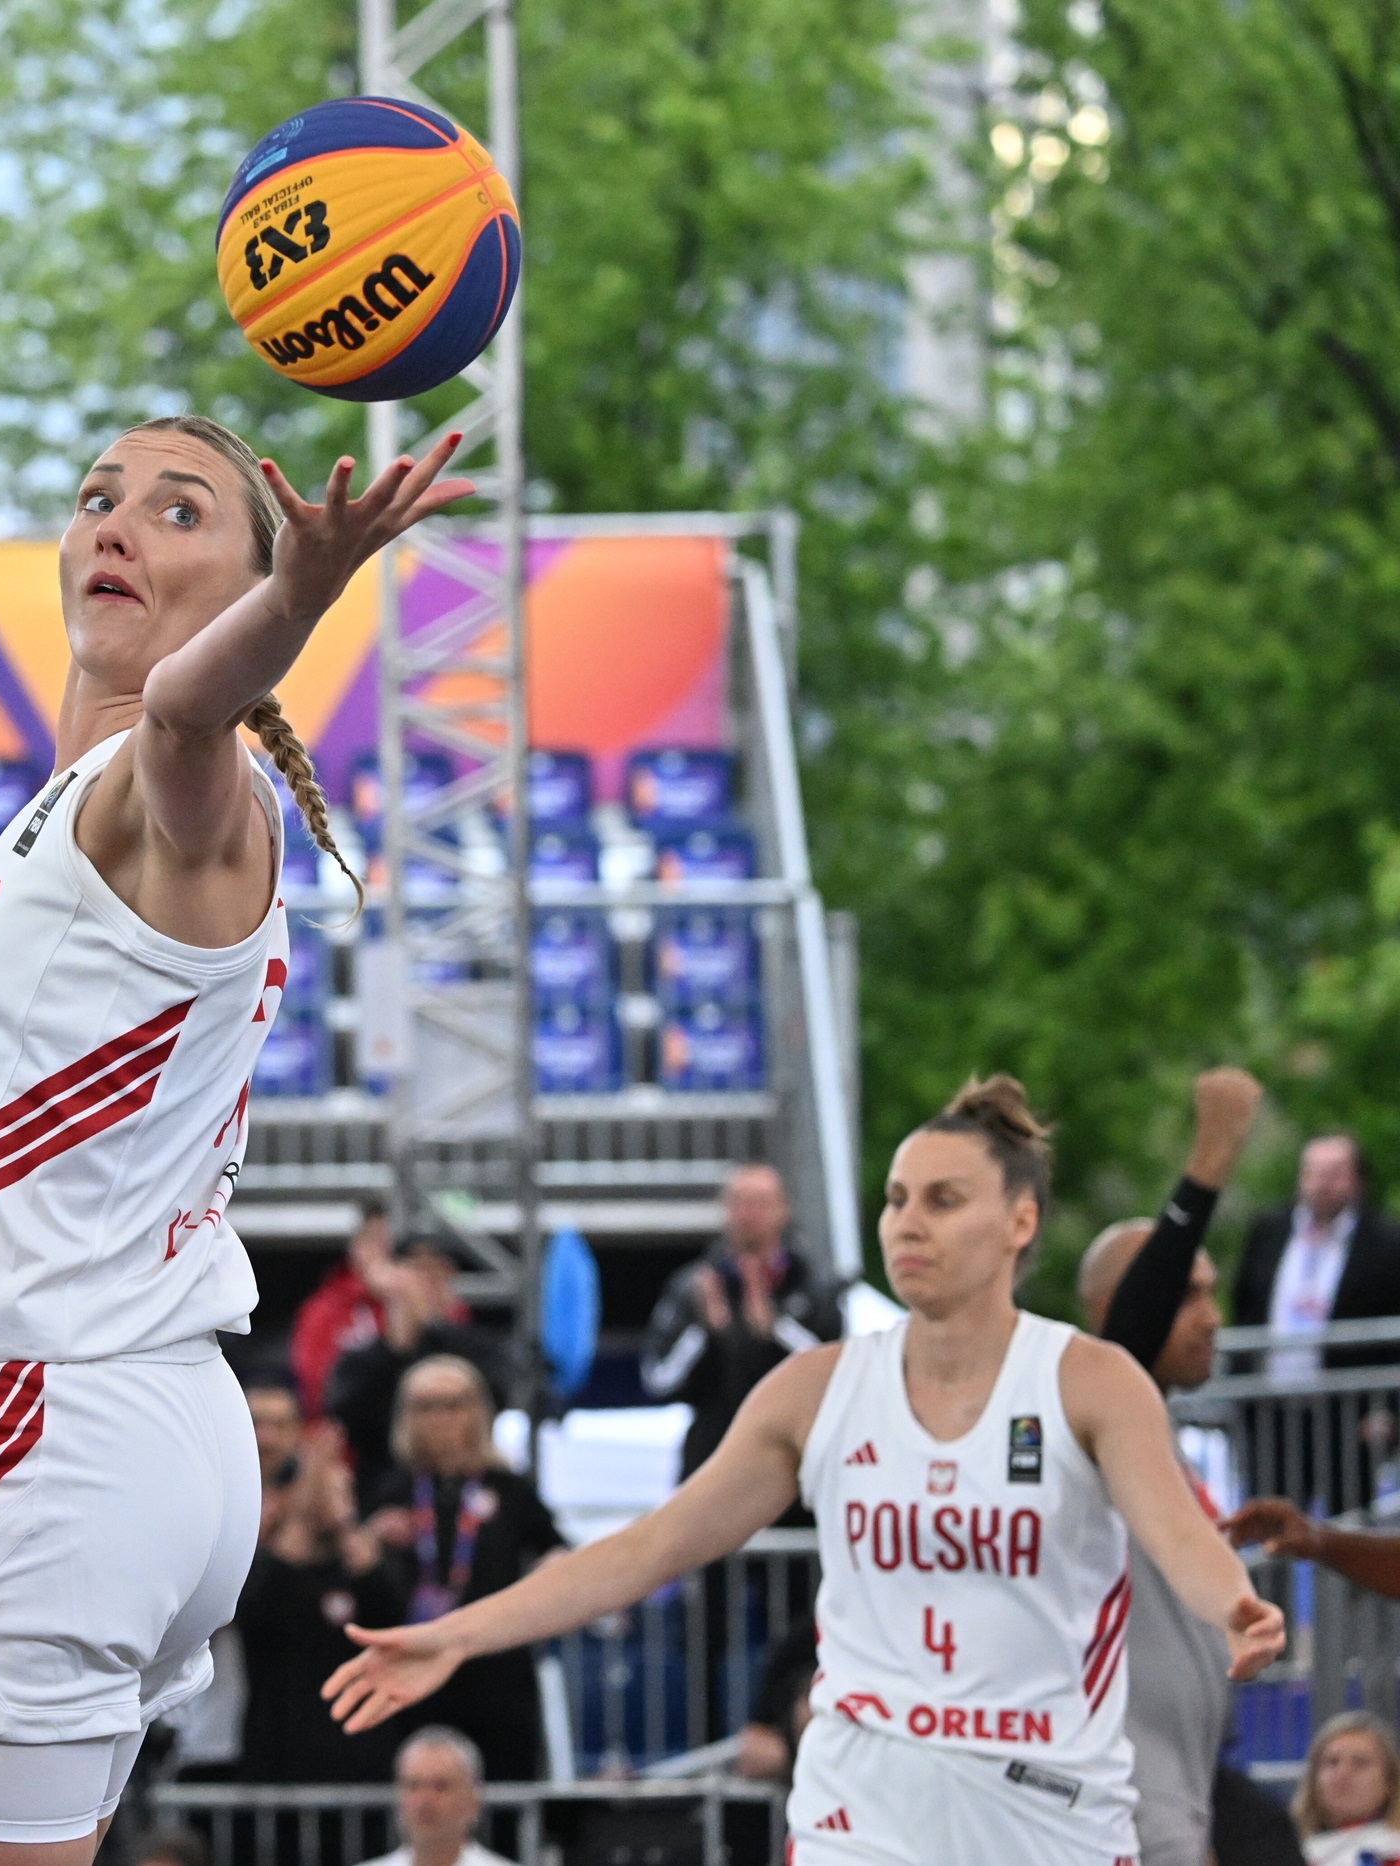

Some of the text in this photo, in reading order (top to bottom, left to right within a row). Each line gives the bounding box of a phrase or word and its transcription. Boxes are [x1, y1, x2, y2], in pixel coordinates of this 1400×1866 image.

[240, 175, 313, 225] OFFICIAL BALL
[273, 194, 300, 215] FIBA
[260, 253, 436, 366] Wilson
[846, 1501, 1041, 1577] POLSKA
[923, 1605, 957, 1673] 4
[907, 1705, 1053, 1743] ORLEN
